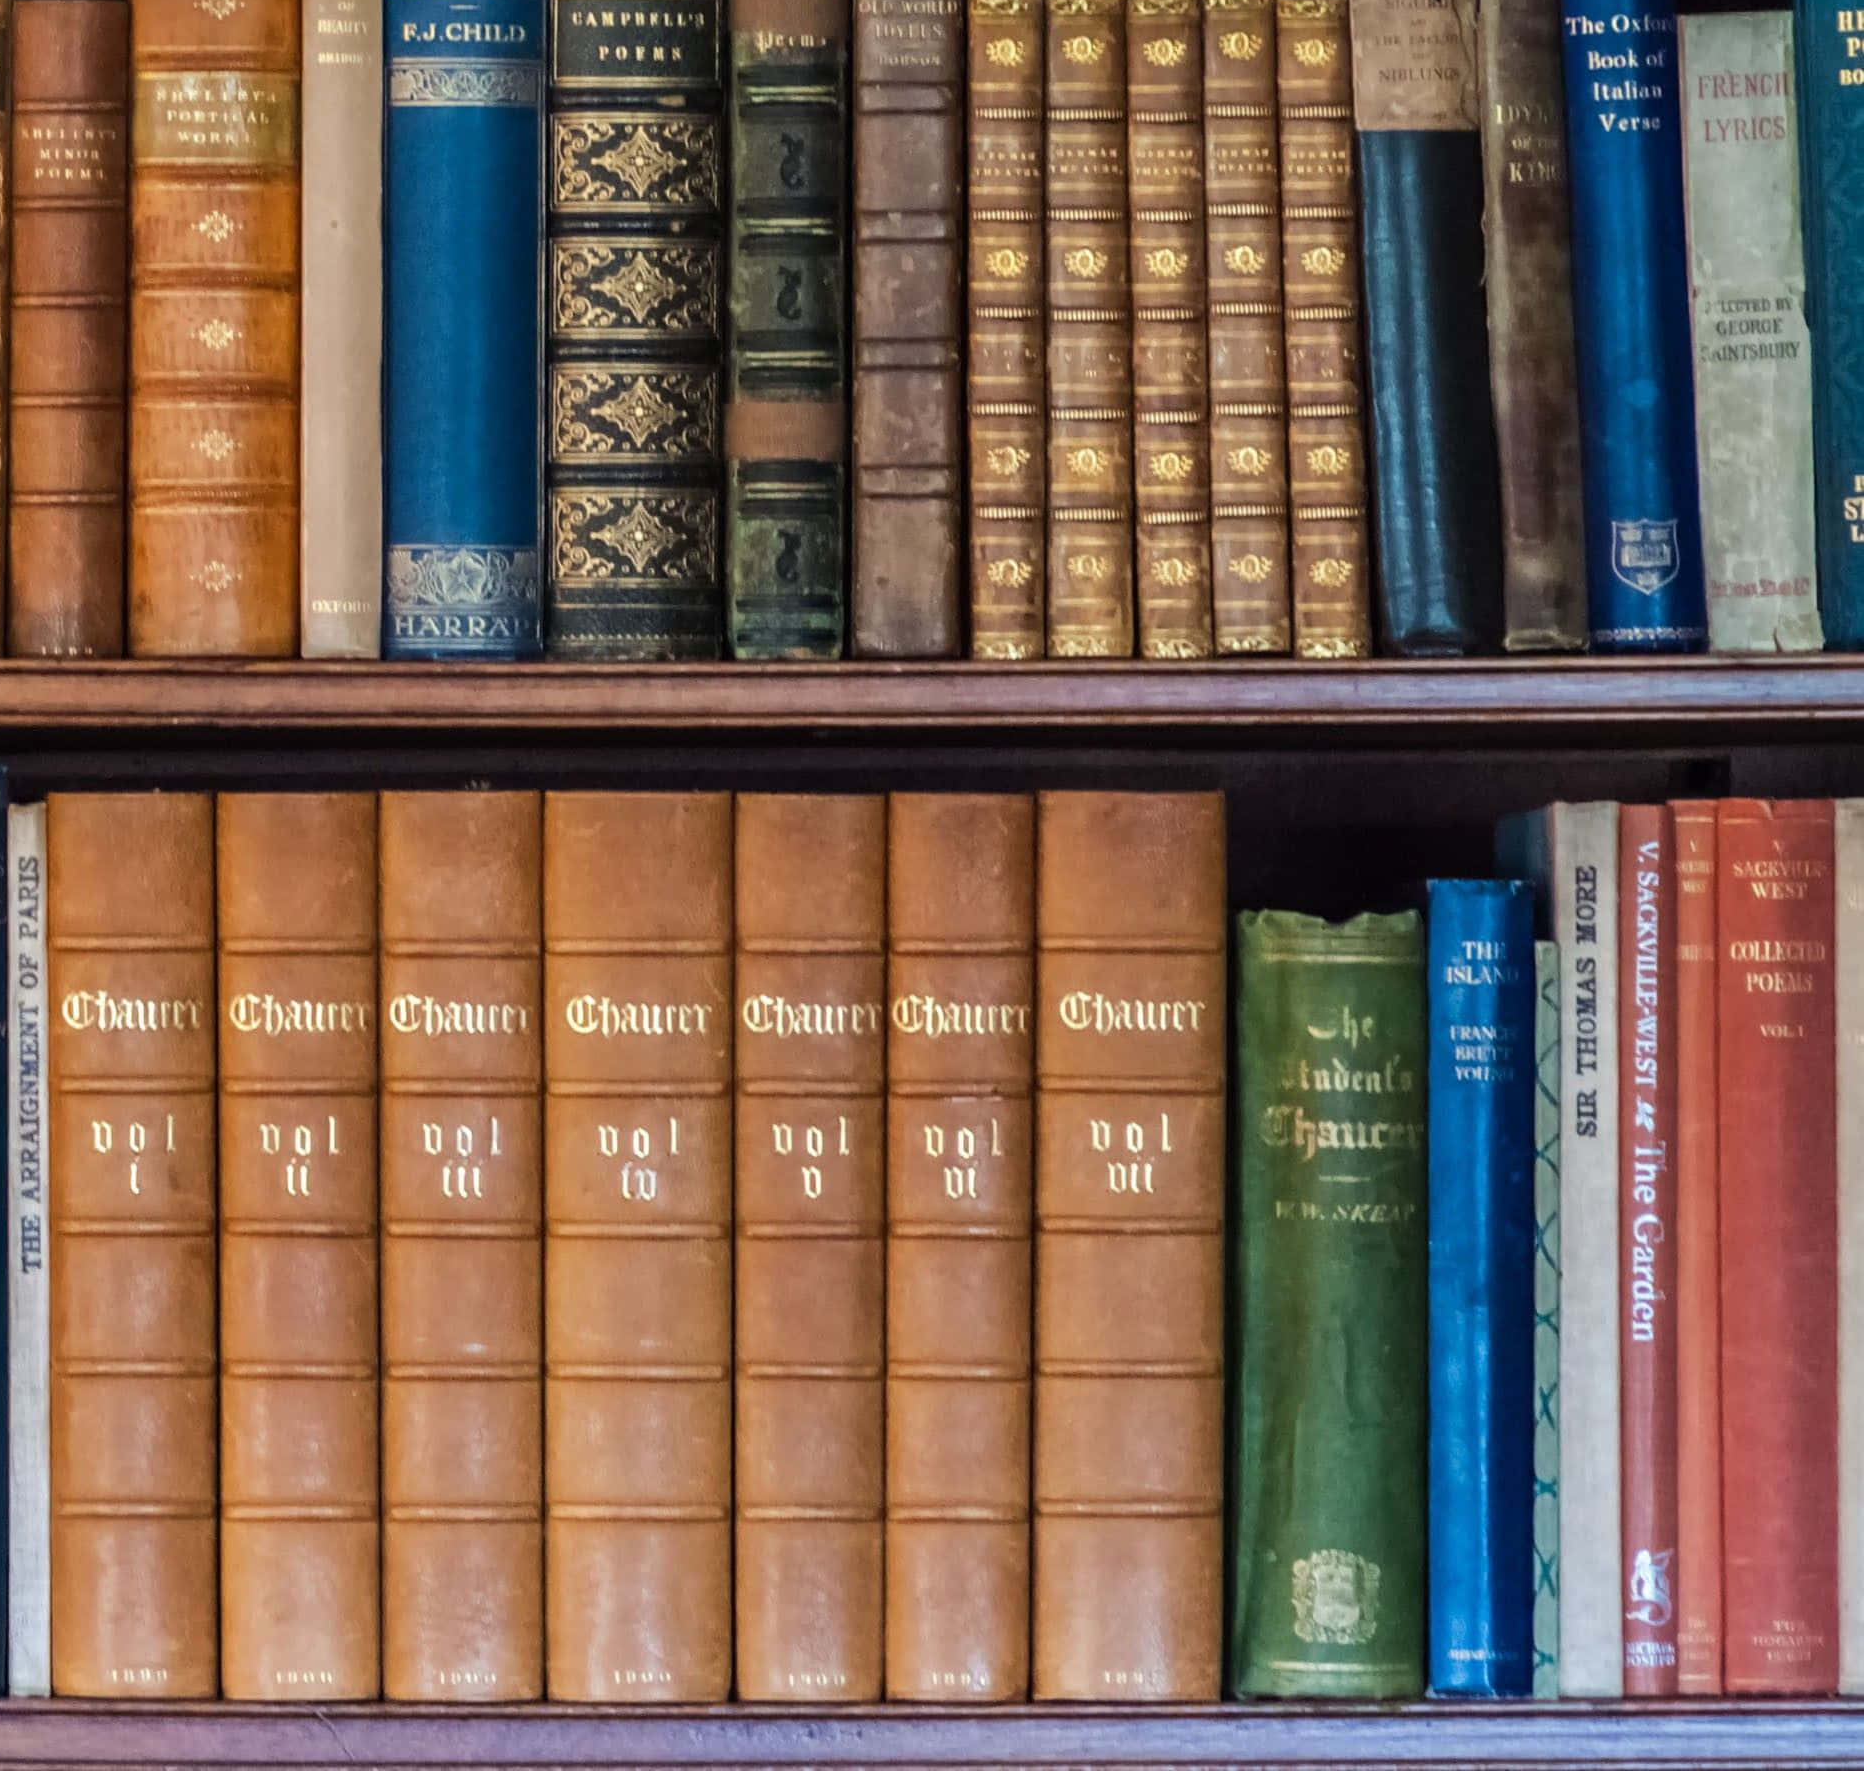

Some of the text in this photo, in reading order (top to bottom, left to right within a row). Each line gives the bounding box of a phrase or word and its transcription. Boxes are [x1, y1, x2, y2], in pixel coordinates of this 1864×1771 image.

[1566, 14, 1604, 37] The
[599, 44, 682, 60] POEMS
[1593, 82, 1663, 101] Italian
[1698, 73, 1788, 100] FRENCH
[1702, 117, 1786, 143] LYRICS
[1716, 317, 1782, 336] GEORGE
[1462, 942, 1506, 961] THE
[1445, 965, 1519, 984] ISLAND
[1746, 971, 1813, 994] POEMS
[61, 990, 203, 1031] Chaucer
[390, 991, 528, 1036] Chaucer
[1576, 864, 1598, 1139] SIR THOMAS MORE
[18, 857, 42, 1274] THE ARRAIGNMENT OF PARIS
[1633, 1140, 1667, 1201] The
[1630, 1214, 1666, 1342] Garden
